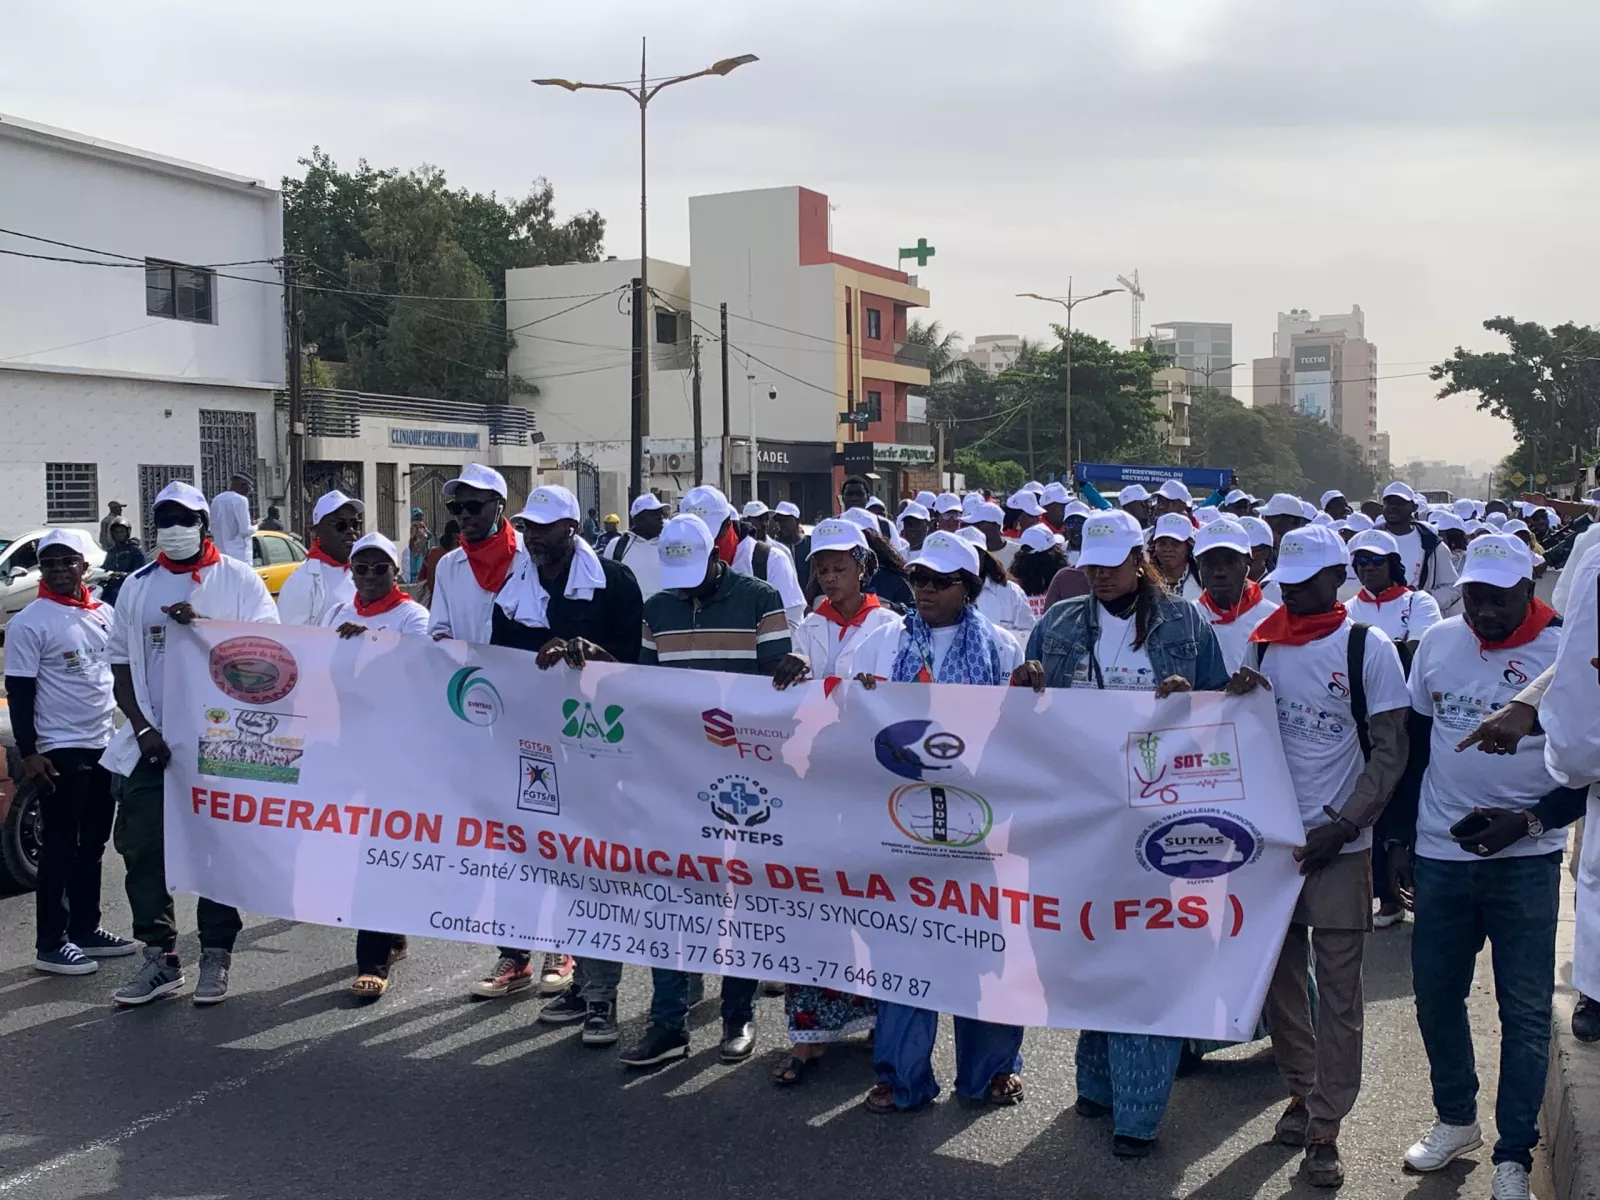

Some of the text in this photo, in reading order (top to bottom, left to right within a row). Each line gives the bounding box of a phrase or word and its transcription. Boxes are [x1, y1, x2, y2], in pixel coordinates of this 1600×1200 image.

[1300, 356, 1325, 364] TECNO
[757, 450, 790, 464] KADEL
[1121, 468, 1172, 477] INTERSYNDICAL
[561, 698, 625, 744] SAS
[519, 739, 552, 754] FGTS/B
[736, 742, 773, 762] FC
[1173, 751, 1231, 769] SDT-3S
[523, 790, 556, 802] FGTS/B
[1162, 807, 1221, 821] TRAVAILLEURS
[701, 826, 784, 847] SYNTEPS
[1165, 836, 1225, 846] SUTMS
[191, 786, 1244, 941] FEDERATION DES SYNDICATS DE LA SANTE ( F2S )
[366, 848, 409, 869] SAS/
[412, 852, 446, 872] SAT
[459, 857, 516, 880] Santé/
[519, 864, 585, 890] SYTRAS/
[588, 876, 740, 910] SUTRACOL-Santé/
[745, 894, 815, 920] SDT-3S/
[819, 903, 918, 936] SYNCOAS/
[922, 919, 1006, 953] STC-HPD
[644, 910, 714, 936] SUTMS/
[717, 918, 786, 944] SNTEPS
[429, 911, 506, 937] Contacts
[590, 931, 621, 952] 475
[625, 935, 646, 956] 24
[649, 941, 670, 959] 63
[686, 944, 708, 963] 77
[712, 948, 746, 968] 653
[751, 951, 774, 970] 76
[778, 955, 801, 974] 43
[816, 960, 839, 980] 77
[844, 965, 877, 988] 646
[881, 972, 903, 992] 87
[908, 977, 931, 998] 87
